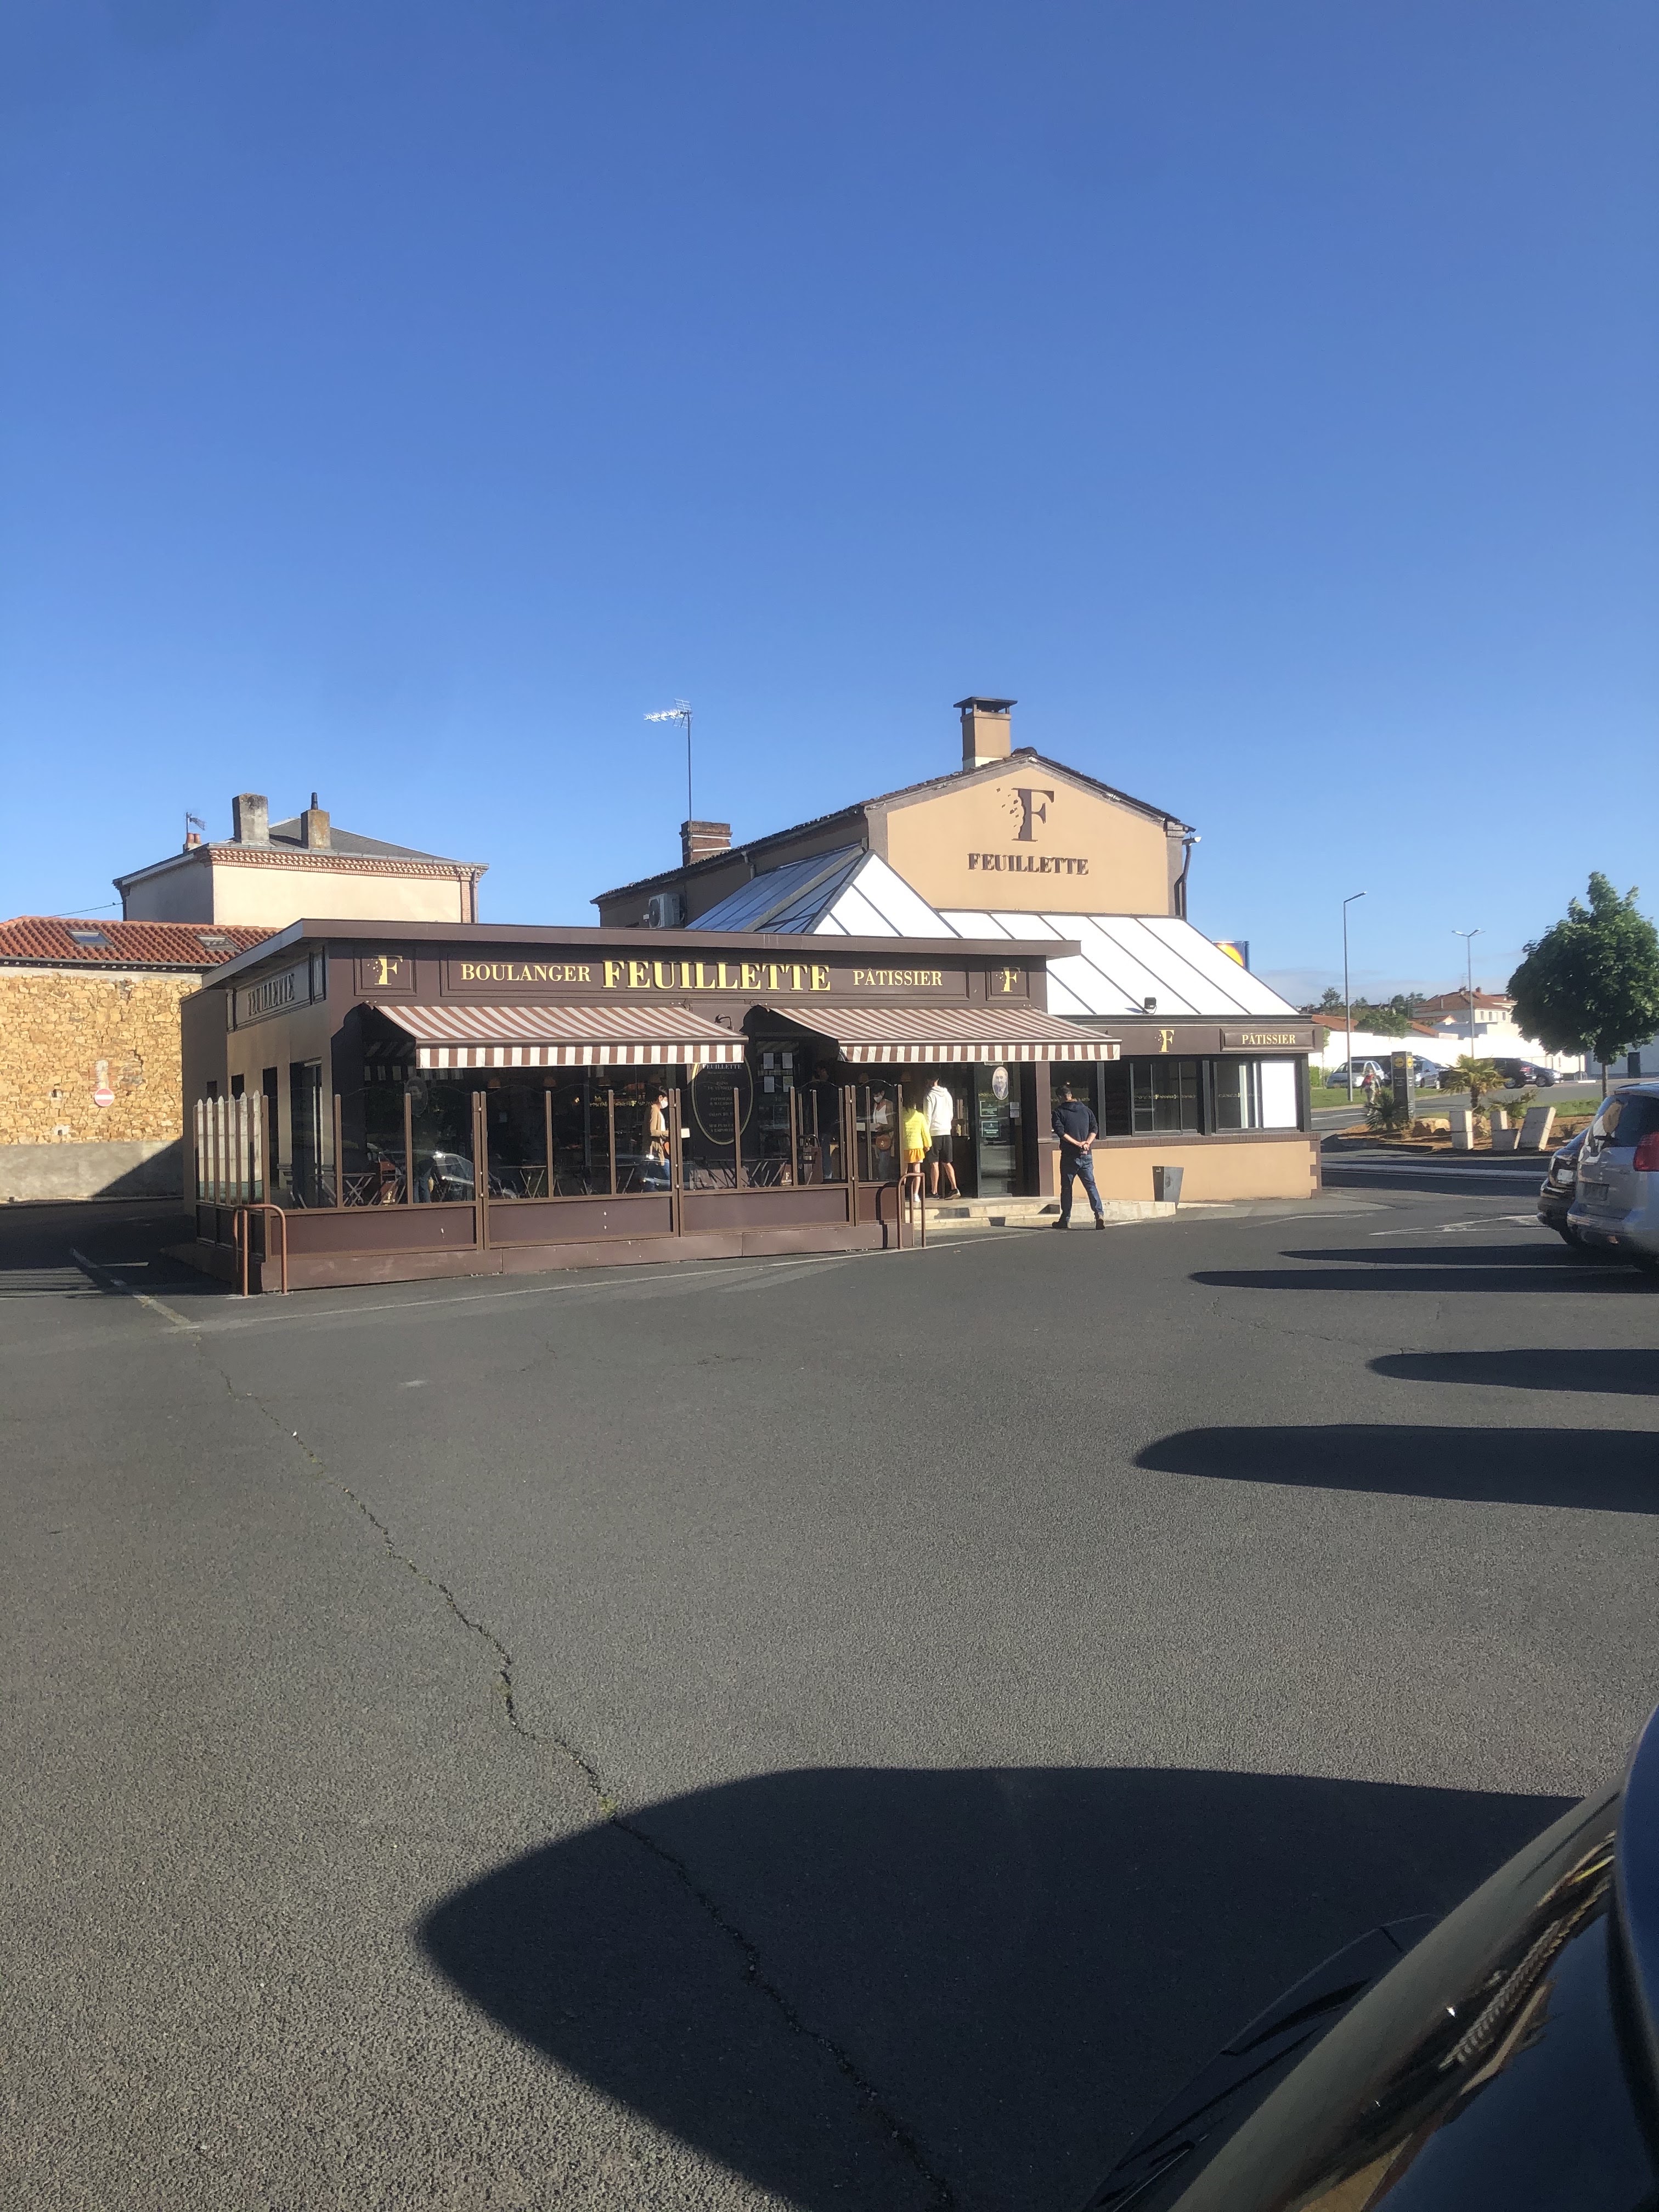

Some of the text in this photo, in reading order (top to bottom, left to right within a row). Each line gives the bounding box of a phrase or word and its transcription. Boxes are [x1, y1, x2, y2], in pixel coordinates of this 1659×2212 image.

[1010, 787, 1055, 843] F
[967, 853, 1089, 876] FEUILLETTE
[374, 955, 403, 986] F
[460, 960, 943, 991] BOULANGER FEUILLETTE PÂTISSIER
[1000, 967, 1021, 992] F
[1158, 1029, 1175, 1053] F
